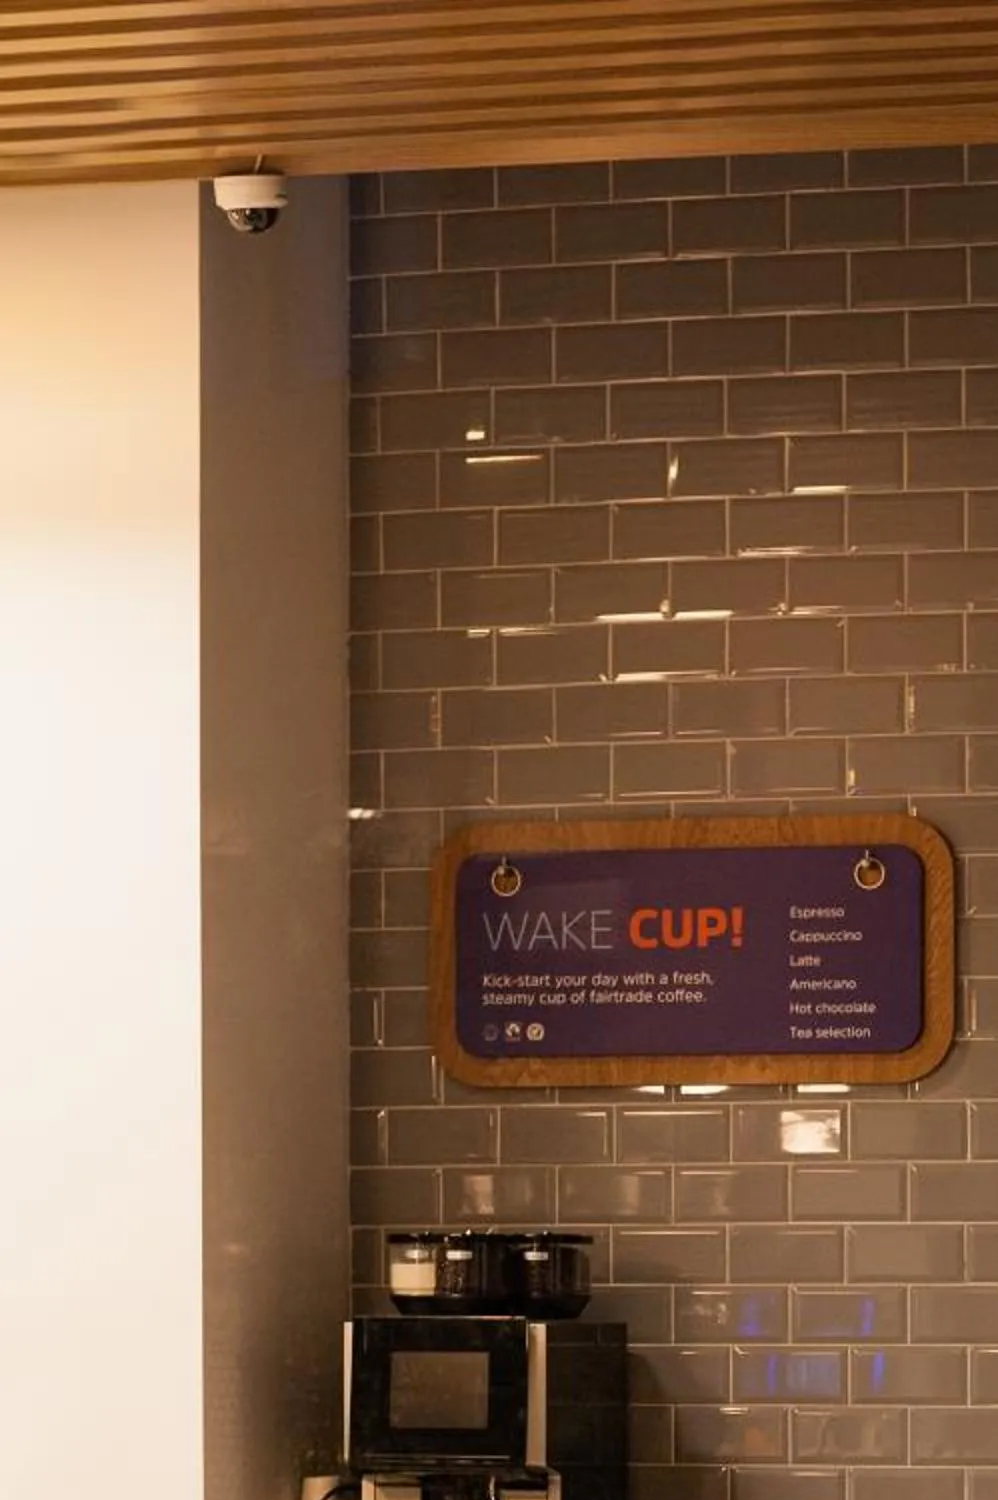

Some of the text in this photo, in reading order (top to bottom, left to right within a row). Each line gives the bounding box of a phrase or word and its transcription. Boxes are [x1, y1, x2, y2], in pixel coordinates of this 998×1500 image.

[790, 905, 845, 920] Espresso
[483, 907, 743, 951] WAKE CUP!
[790, 929, 862, 942] Cappuccino
[790, 955, 820, 967] Latte
[482, 973, 550, 988] Kick-start
[556, 974, 587, 989] your
[592, 971, 618, 987] day
[623, 972, 655, 986] with
[659, 974, 669, 985] a
[790, 978, 857, 990] Americano
[482, 992, 535, 1007] steamy
[539, 992, 567, 1006] cup
[571, 991, 585, 1006] of
[588, 989, 652, 1004] fairtrade
[789, 1001, 876, 1014] Hot chocolate
[790, 1024, 871, 1038] Tea selection
